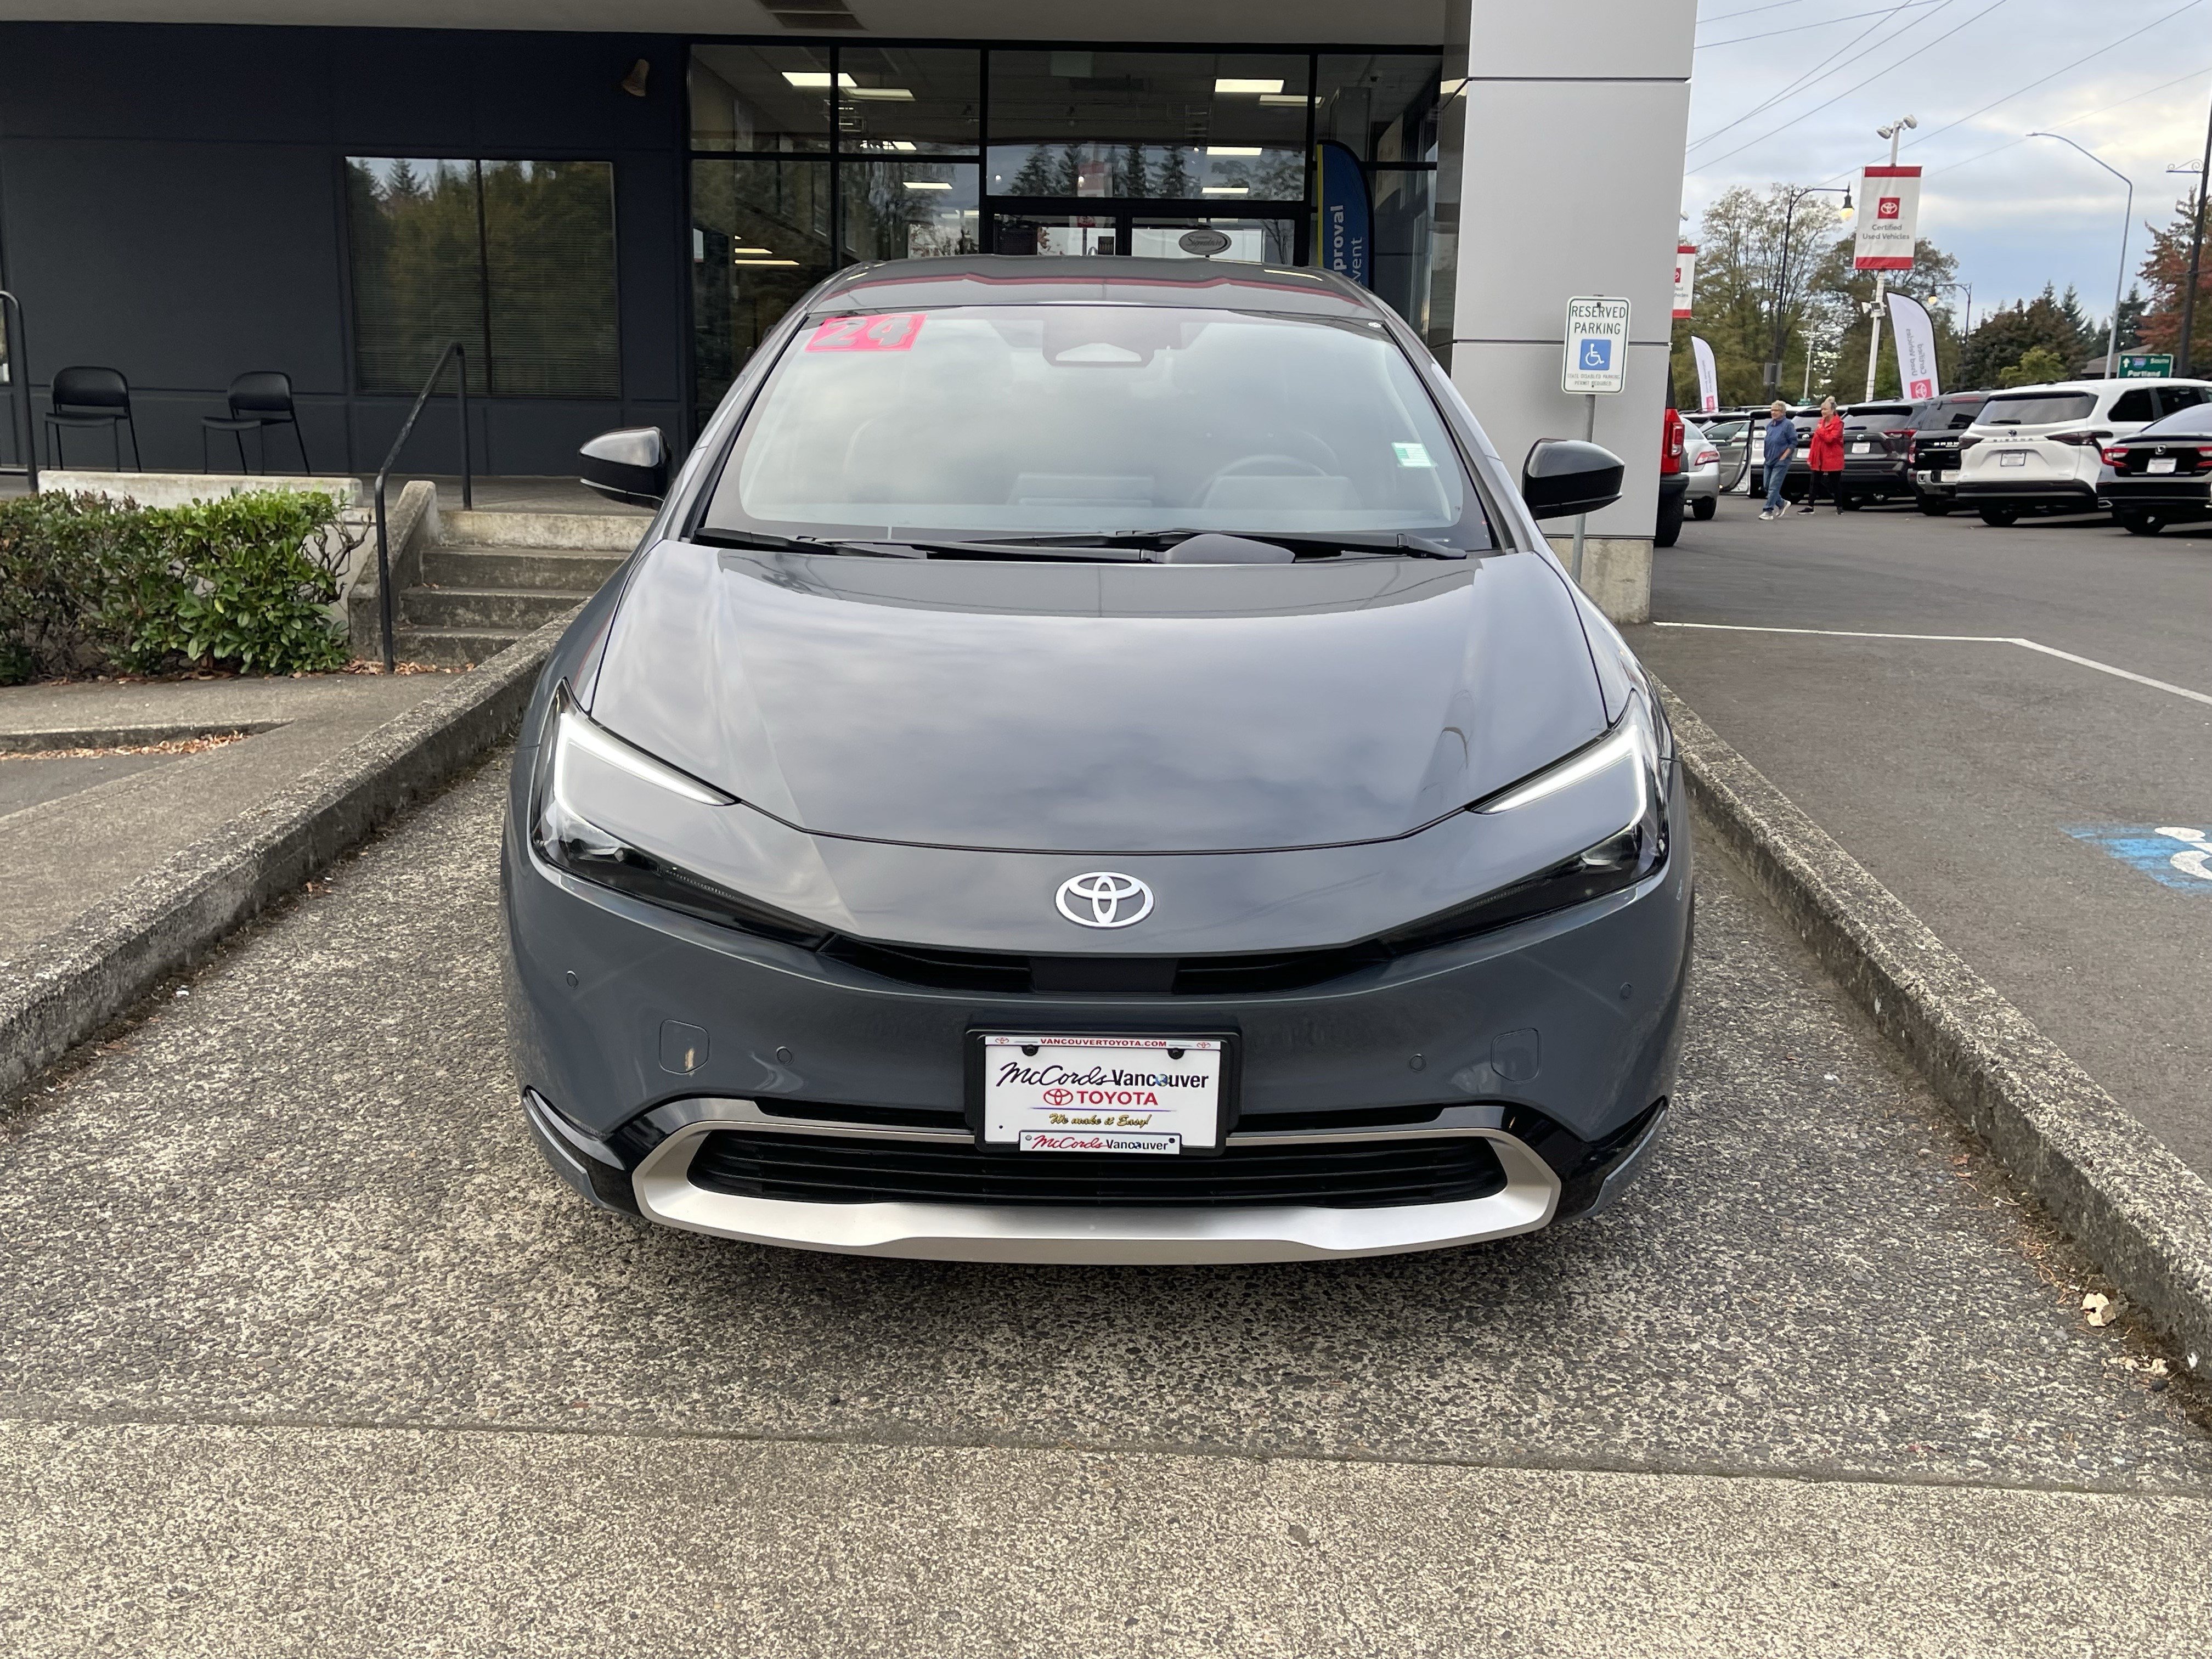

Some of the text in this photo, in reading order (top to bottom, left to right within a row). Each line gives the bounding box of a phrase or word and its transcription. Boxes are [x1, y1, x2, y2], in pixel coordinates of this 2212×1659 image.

[1330, 205, 1347, 274] proval
[1351, 236, 1363, 284] vent
[1571, 305, 1626, 318] RESERVED
[812, 317, 912, 347] 24
[1574, 322, 1621, 335] PARKING
[1040, 1038, 1167, 1047] VANCOUVERTOYOTA.COM
[996, 1062, 1209, 1088] McCords Vancouver
[1077, 1091, 1158, 1105] TOYOTA
[1049, 1113, 1153, 1129] We make it Easy!
